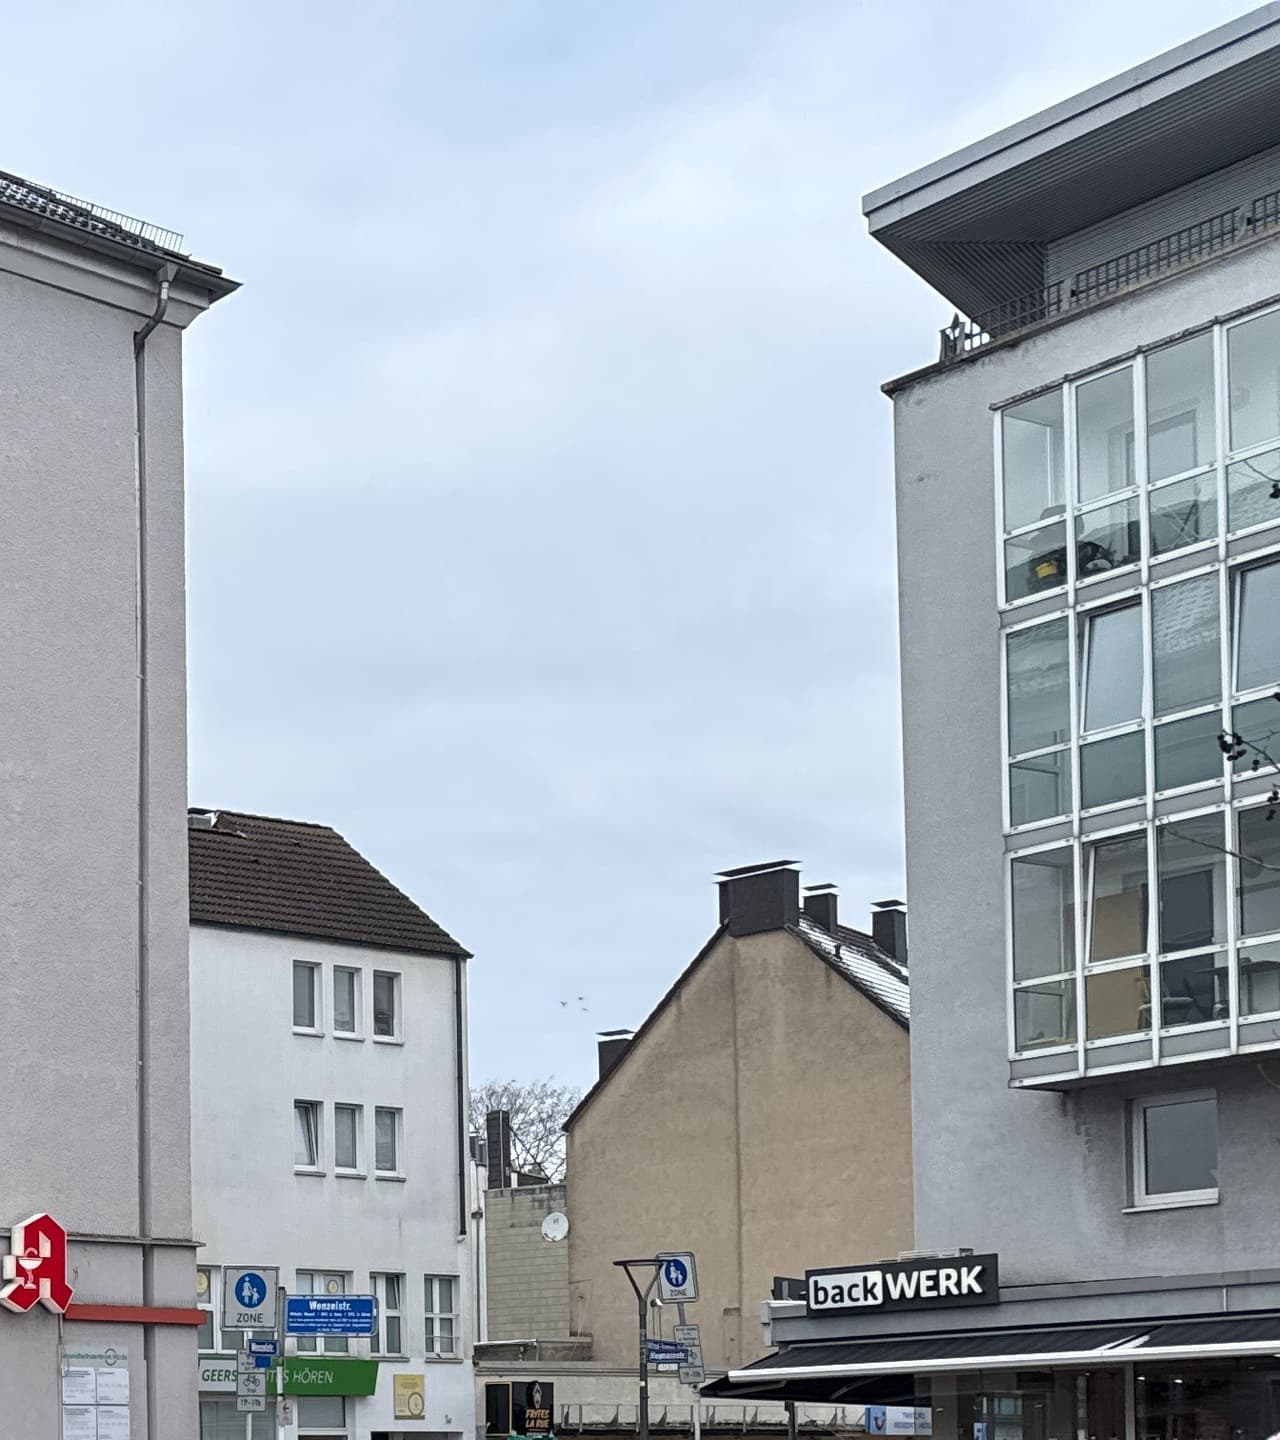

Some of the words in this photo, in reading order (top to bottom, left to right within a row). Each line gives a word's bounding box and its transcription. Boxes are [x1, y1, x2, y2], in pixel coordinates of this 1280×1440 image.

[236, 1312, 264, 1324] ZONE
[201, 1369, 238, 1382] GEERS
[293, 1367, 334, 1384] HÖREN
